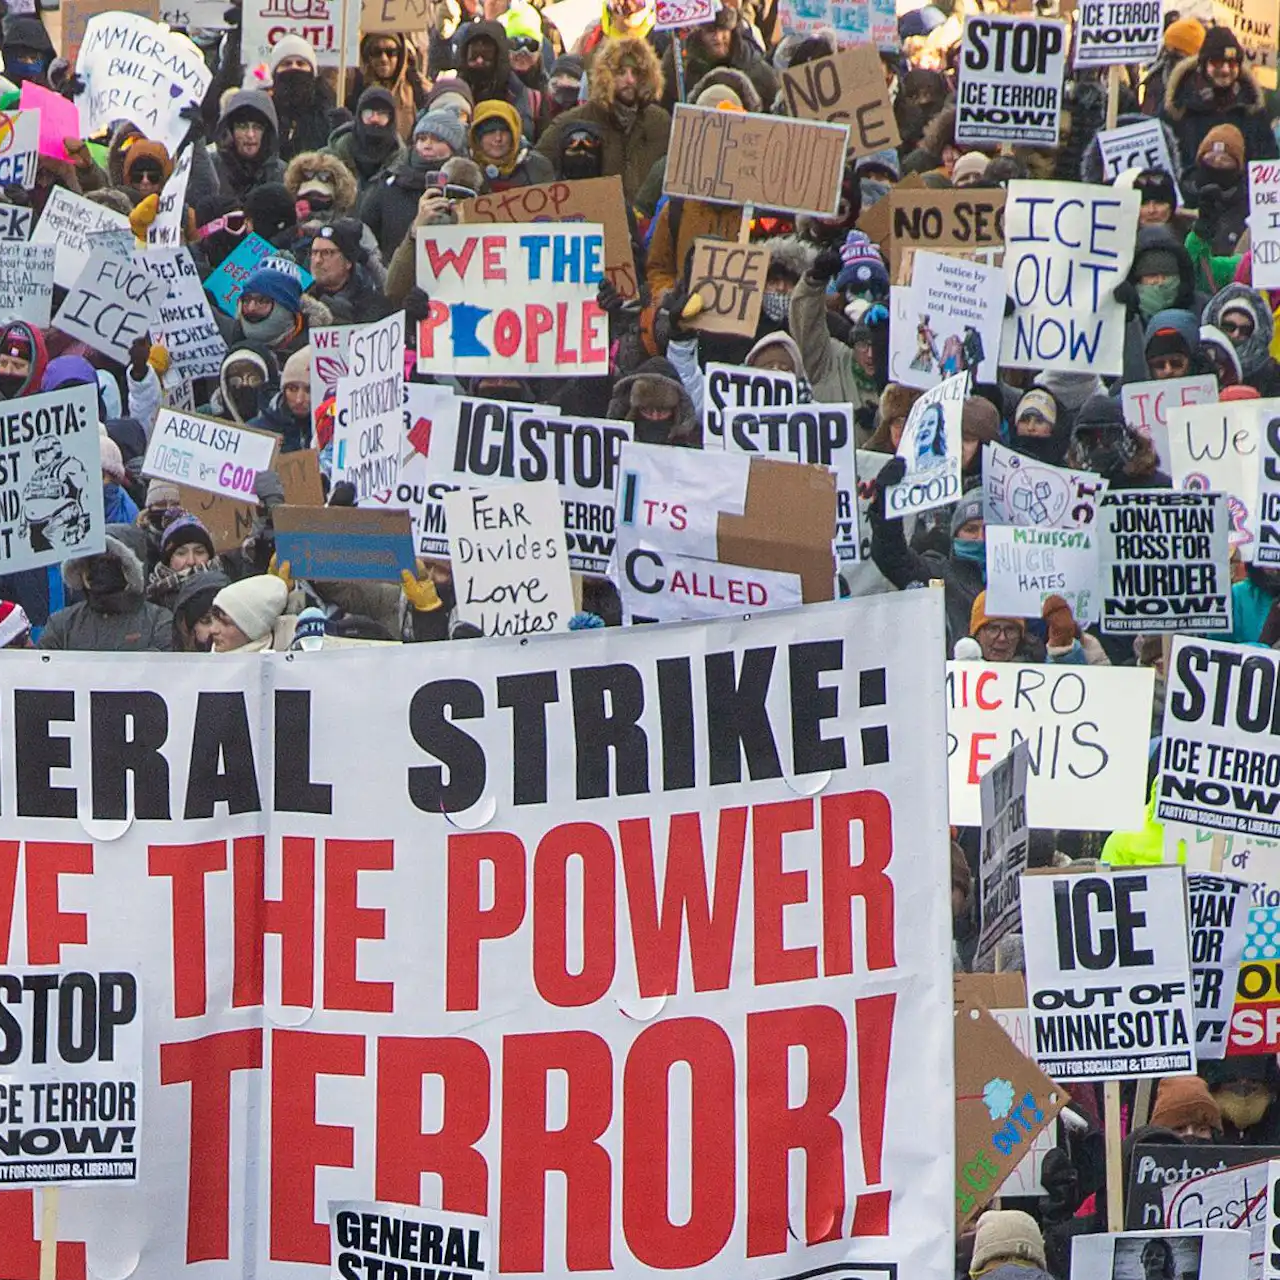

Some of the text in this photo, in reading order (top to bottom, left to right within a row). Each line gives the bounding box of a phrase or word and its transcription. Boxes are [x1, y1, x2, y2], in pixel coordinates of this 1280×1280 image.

[1108, 0, 1160, 26] TERROR
[965, 19, 1061, 75] STOP
[1080, 27, 1160, 46] NOW!
[108, 57, 165, 89] BUILT
[783, 59, 841, 119] NO
[961, 81, 1057, 110] ICE TERROR
[960, 107, 1057, 130] NOW!
[761, 122, 846, 213] OUT
[475, 184, 570, 219] STOP
[894, 206, 943, 240] NO
[1010, 196, 1123, 259] ICE
[425, 235, 507, 281] WE
[519, 235, 604, 285] THE
[702, 245, 761, 283] ICE
[935, 261, 987, 284] Justice by
[97, 259, 159, 307] FUCK
[689, 280, 761, 322] OUT
[928, 288, 977, 308] terrorism
[943, 280, 977, 294] way of
[1014, 253, 1119, 314] OUT
[63, 289, 148, 350] ICE
[159, 303, 204, 324] HOCKEY
[927, 299, 984, 321] not justice.
[313, 332, 340, 349] WE
[353, 319, 401, 378] STOP
[1014, 315, 1104, 365] NOW
[164, 416, 242, 455] ABOLISH
[358, 423, 385, 459] OUR
[1186, 416, 1258, 462] We
[153, 443, 193, 479] ICE
[890, 474, 959, 511] GOOD
[1099, 492, 1223, 508] ARREST
[470, 494, 533, 532] FEAR
[1109, 507, 1216, 535] JONATHAN
[458, 533, 557, 566] Divides
[993, 542, 1056, 576] NICE
[1115, 534, 1212, 560] ROSS FOR
[465, 576, 548, 605] Love
[624, 546, 769, 607] CALLED
[1018, 573, 1066, 594] HATES
[1111, 562, 1218, 597] MURDER
[1104, 596, 1227, 616] NOW!
[479, 611, 558, 638] Unites
[407, 639, 891, 816] STRIKE:
[1163, 737, 1203, 776] ICE
[146, 833, 395, 1019] THE
[445, 789, 896, 1012] POWER
[1053, 874, 1156, 973] ICE
[1032, 982, 1186, 1011] OUT OF
[1033, 1007, 1190, 1055] MINNESOTA
[29, 1079, 137, 1124] TERROR
[159, 993, 897, 1275] TERROR!
[26, 1162, 70, 1180] SOCIALISM
[83, 1161, 133, 1179] LIBERATION
[335, 1210, 485, 1272] GENERAL
